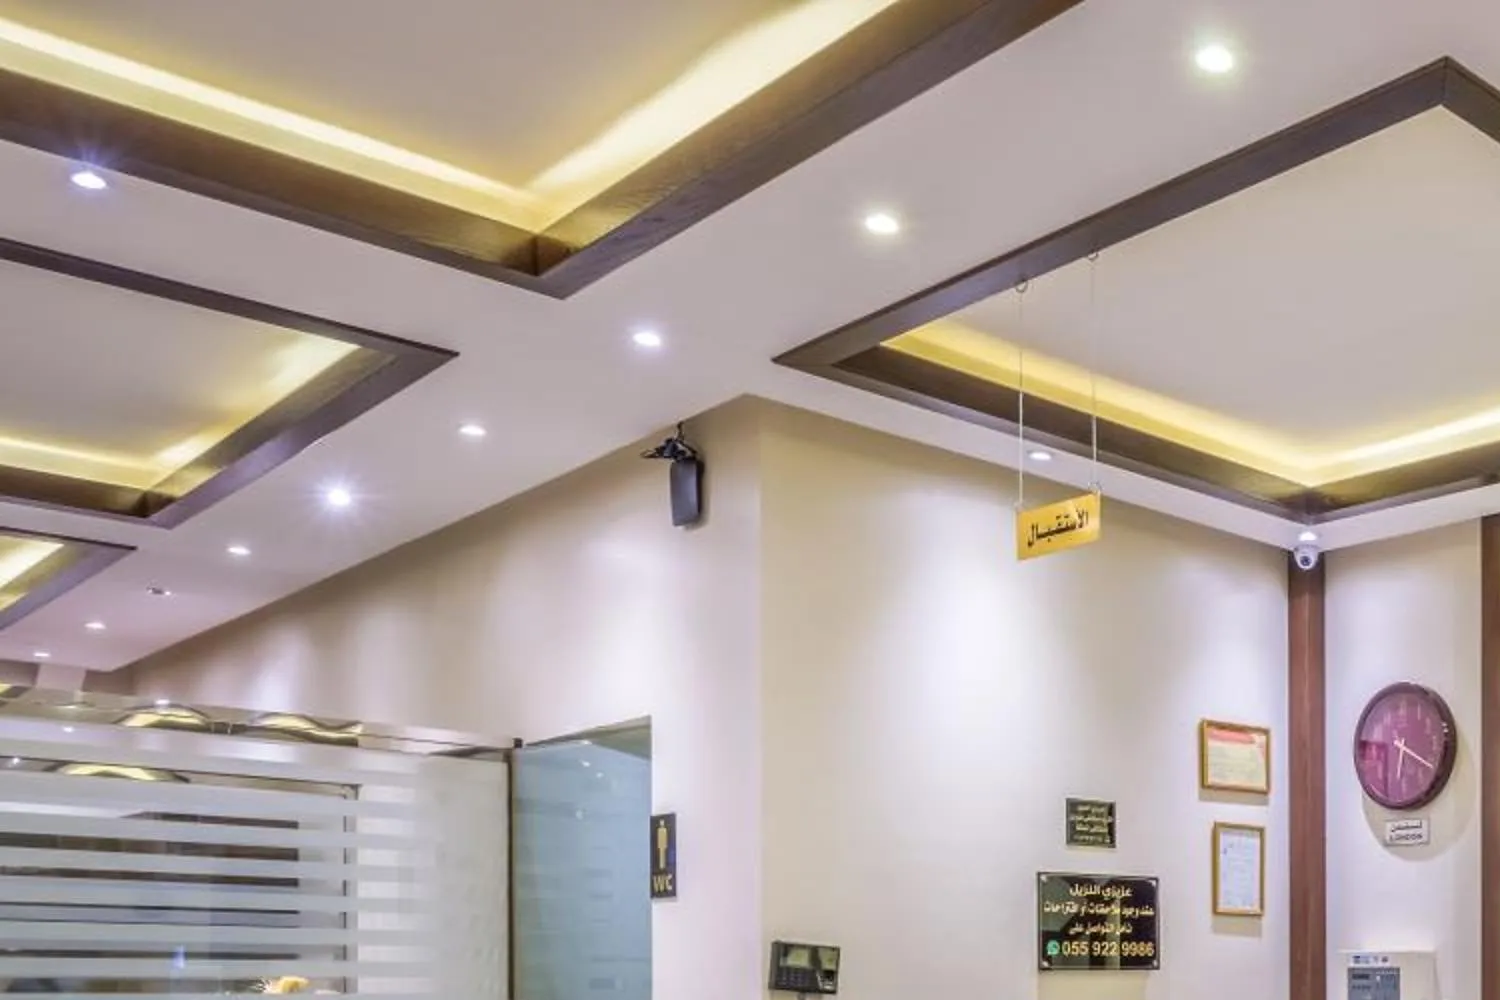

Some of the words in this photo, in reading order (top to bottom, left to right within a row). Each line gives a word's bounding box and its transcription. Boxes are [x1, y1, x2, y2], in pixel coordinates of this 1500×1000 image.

[653, 873, 673, 892] WC
[1069, 884, 1100, 897] النزيل
[1102, 885, 1134, 901] عزيزي
[1062, 941, 1089, 957] 055
[1092, 941, 1118, 957] 922
